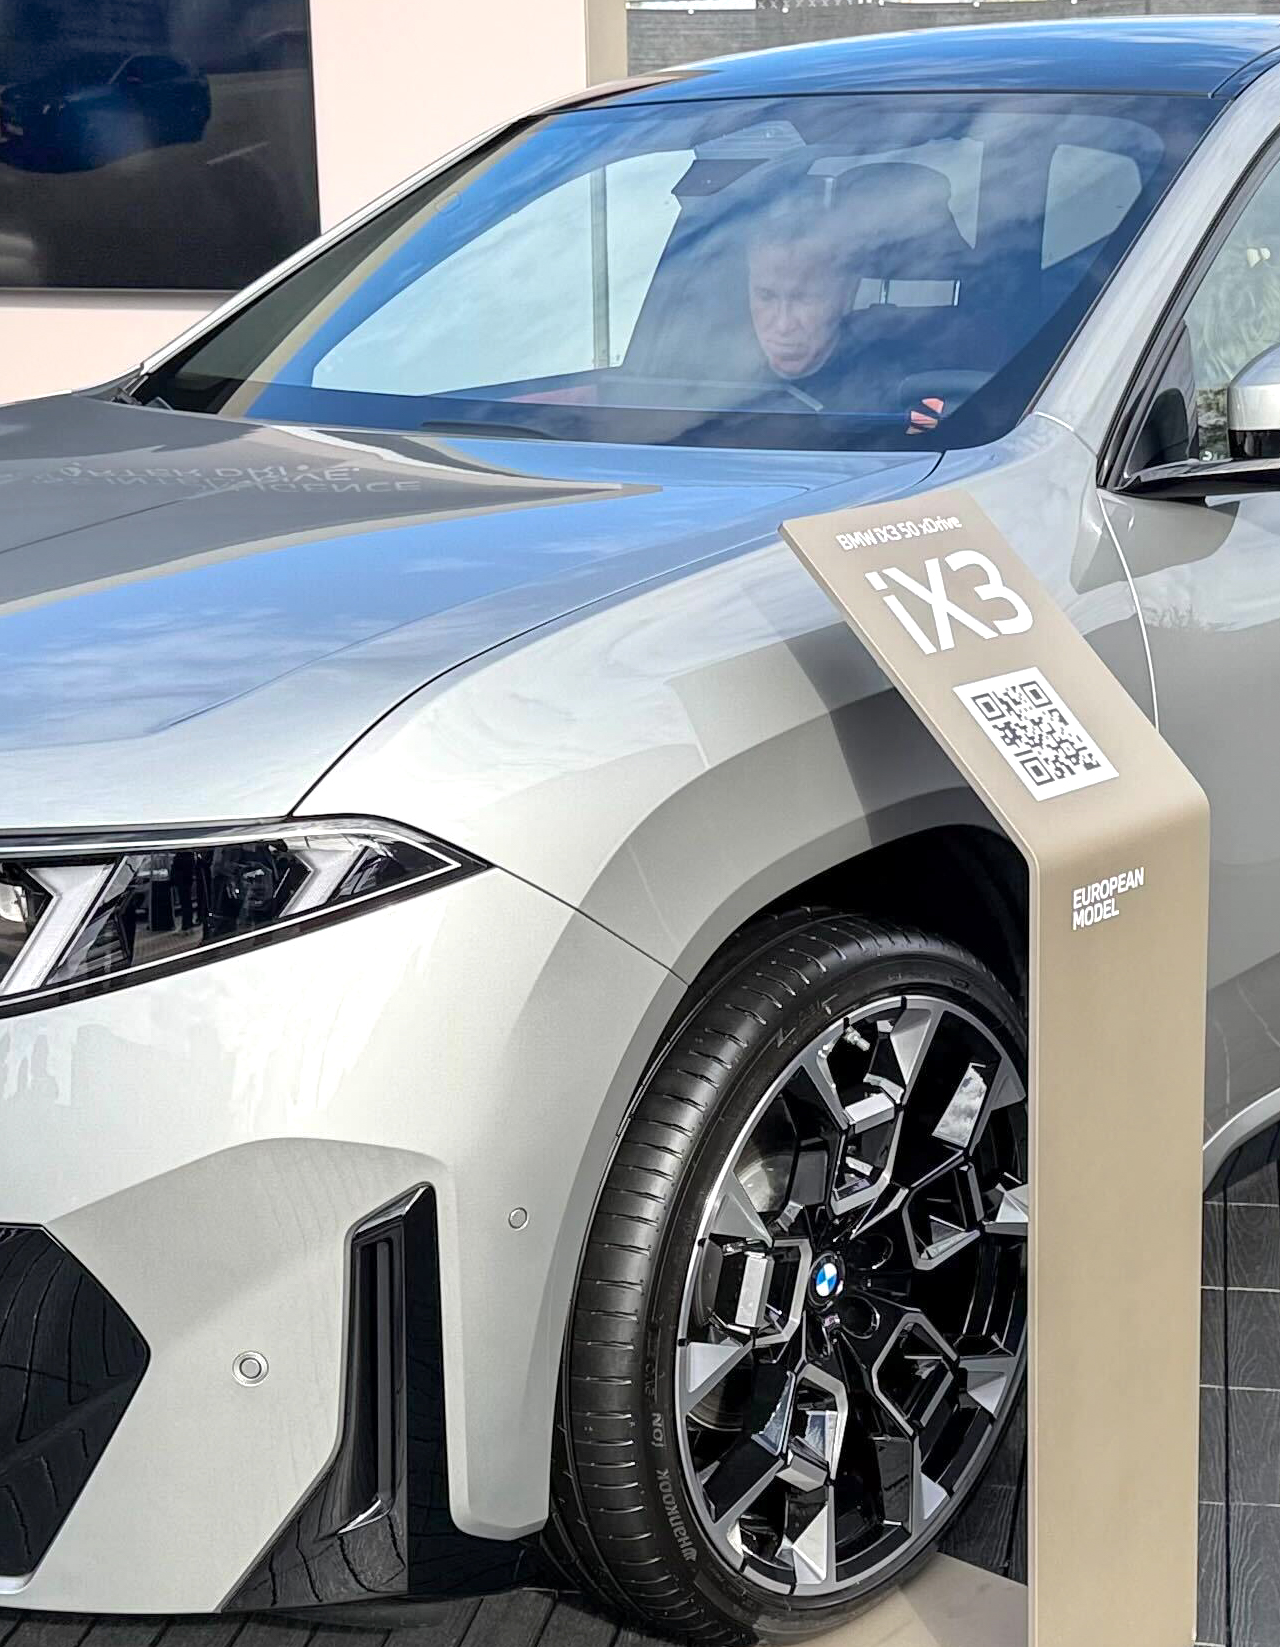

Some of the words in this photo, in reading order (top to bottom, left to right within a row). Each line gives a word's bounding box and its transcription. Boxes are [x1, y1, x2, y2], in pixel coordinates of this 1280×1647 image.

[835, 528, 878, 551] BMW
[873, 524, 902, 543] iX3
[896, 520, 921, 539] 50
[918, 515, 963, 535] xDrive
[864, 549, 1034, 655] iX3
[1072, 866, 1145, 910] EUROPEAN
[1072, 897, 1120, 931] MODEL
